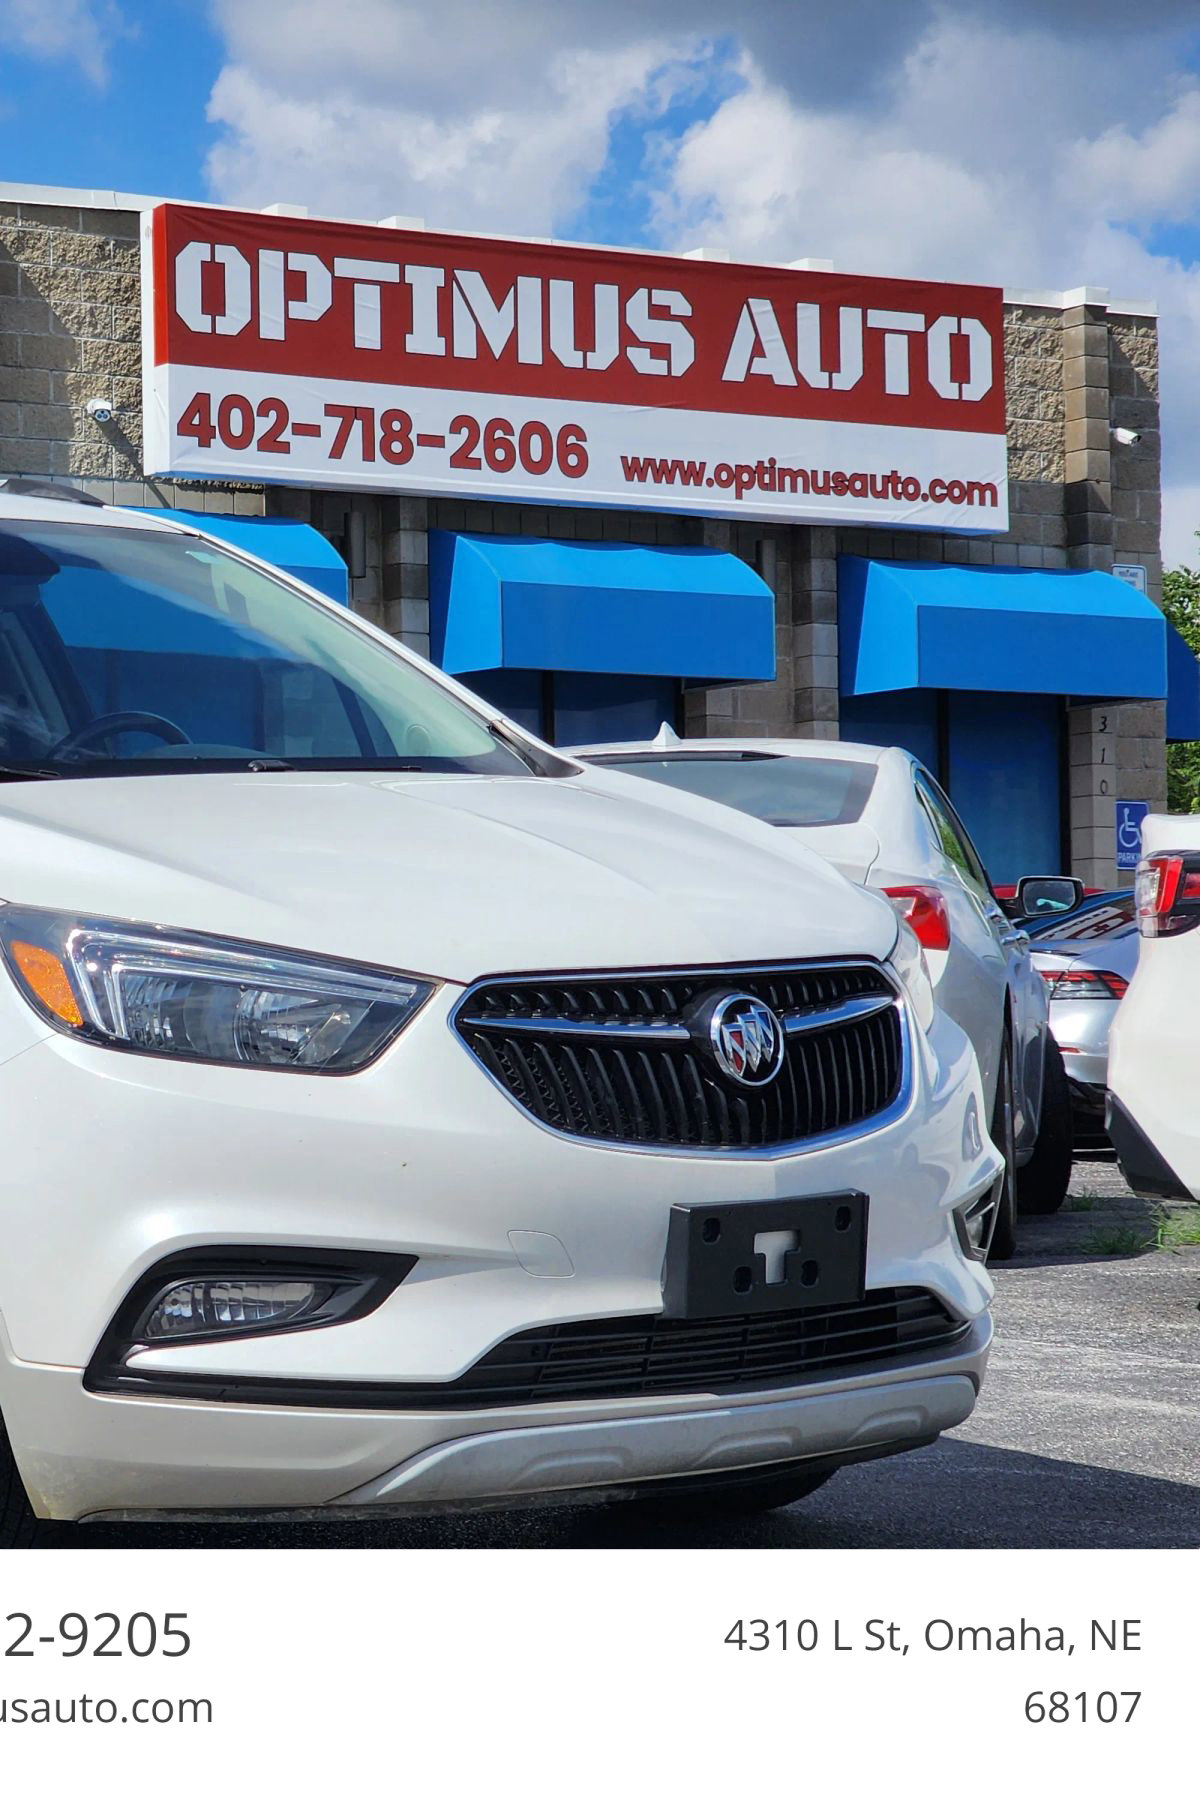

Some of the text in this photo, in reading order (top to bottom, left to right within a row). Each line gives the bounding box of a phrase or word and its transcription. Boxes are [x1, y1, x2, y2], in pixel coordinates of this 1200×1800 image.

[175, 241, 993, 401] OPTIMUS AUTO
[176, 392, 590, 479] 402-718-2606
[620, 455, 999, 508] www.optimusauto.com
